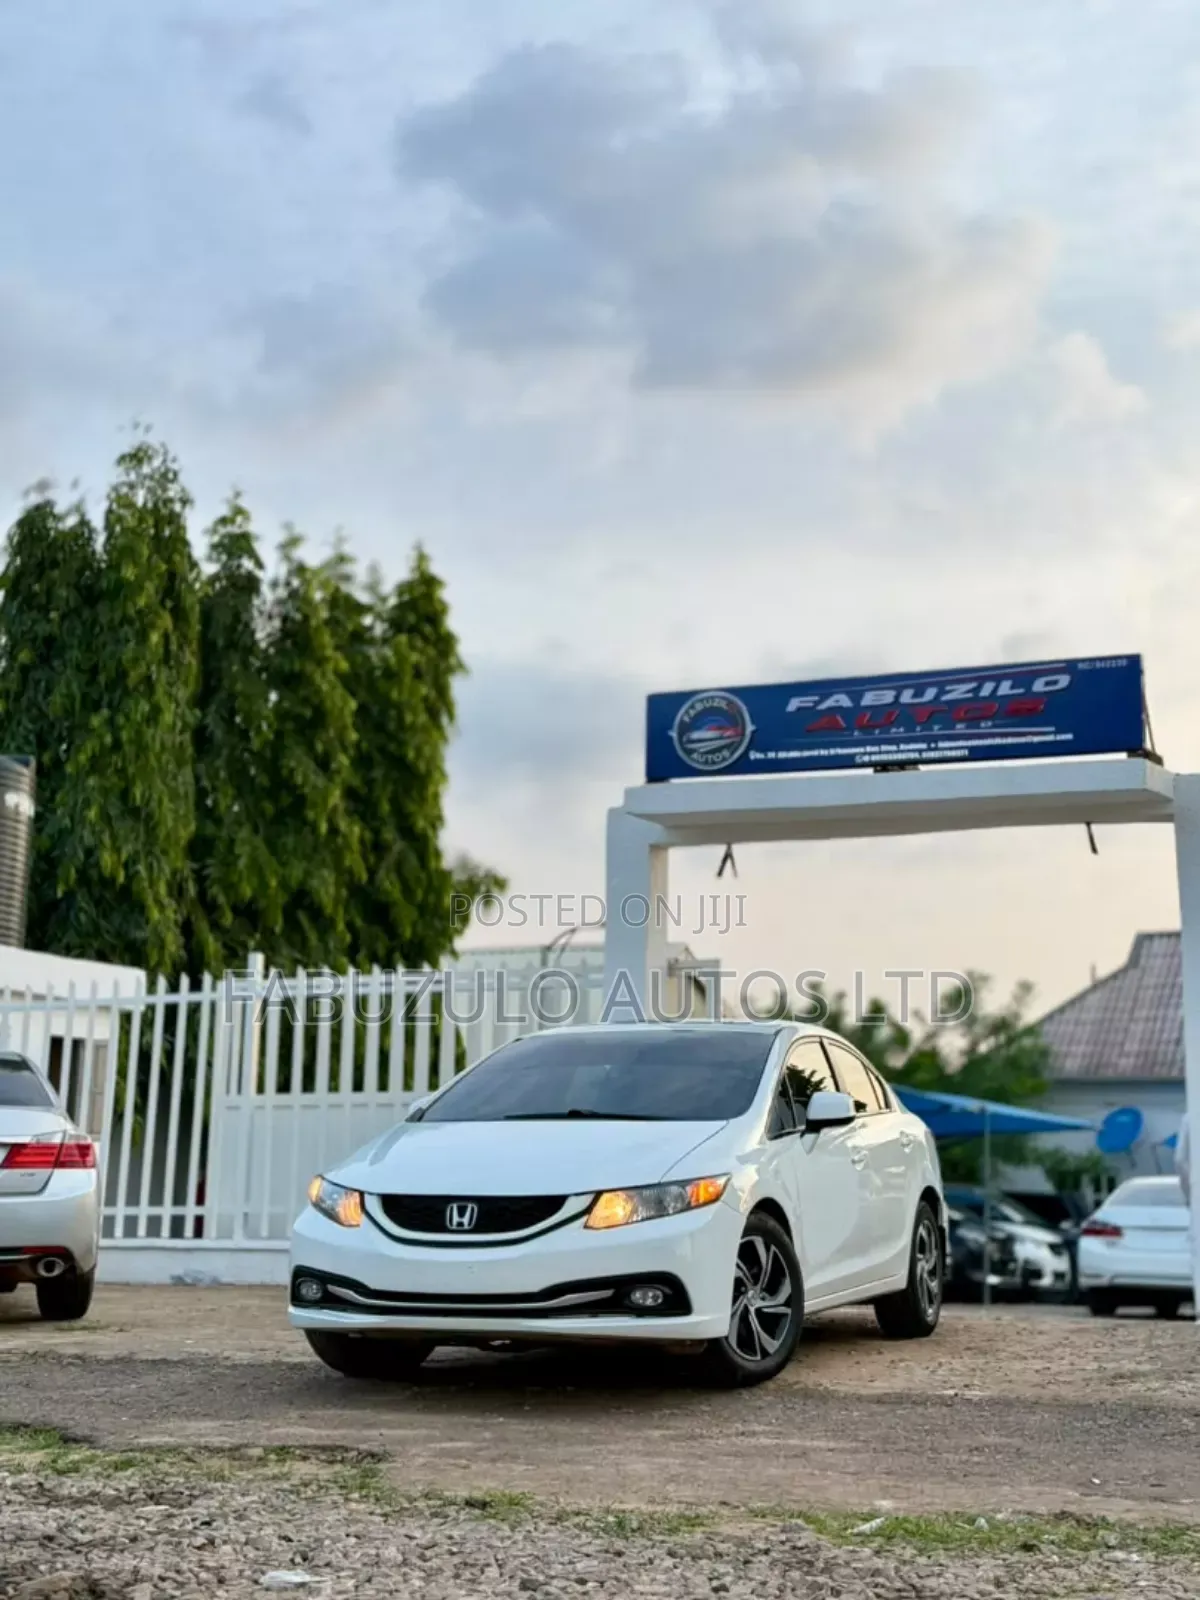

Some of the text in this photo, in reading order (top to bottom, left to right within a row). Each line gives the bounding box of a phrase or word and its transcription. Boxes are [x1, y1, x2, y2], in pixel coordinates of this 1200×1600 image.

[785, 673, 1072, 713] FABUZILO
[804, 696, 1047, 733] AUTOS
[852, 720, 994, 737] LIMITED
[690, 749, 731, 765] AUTOS
